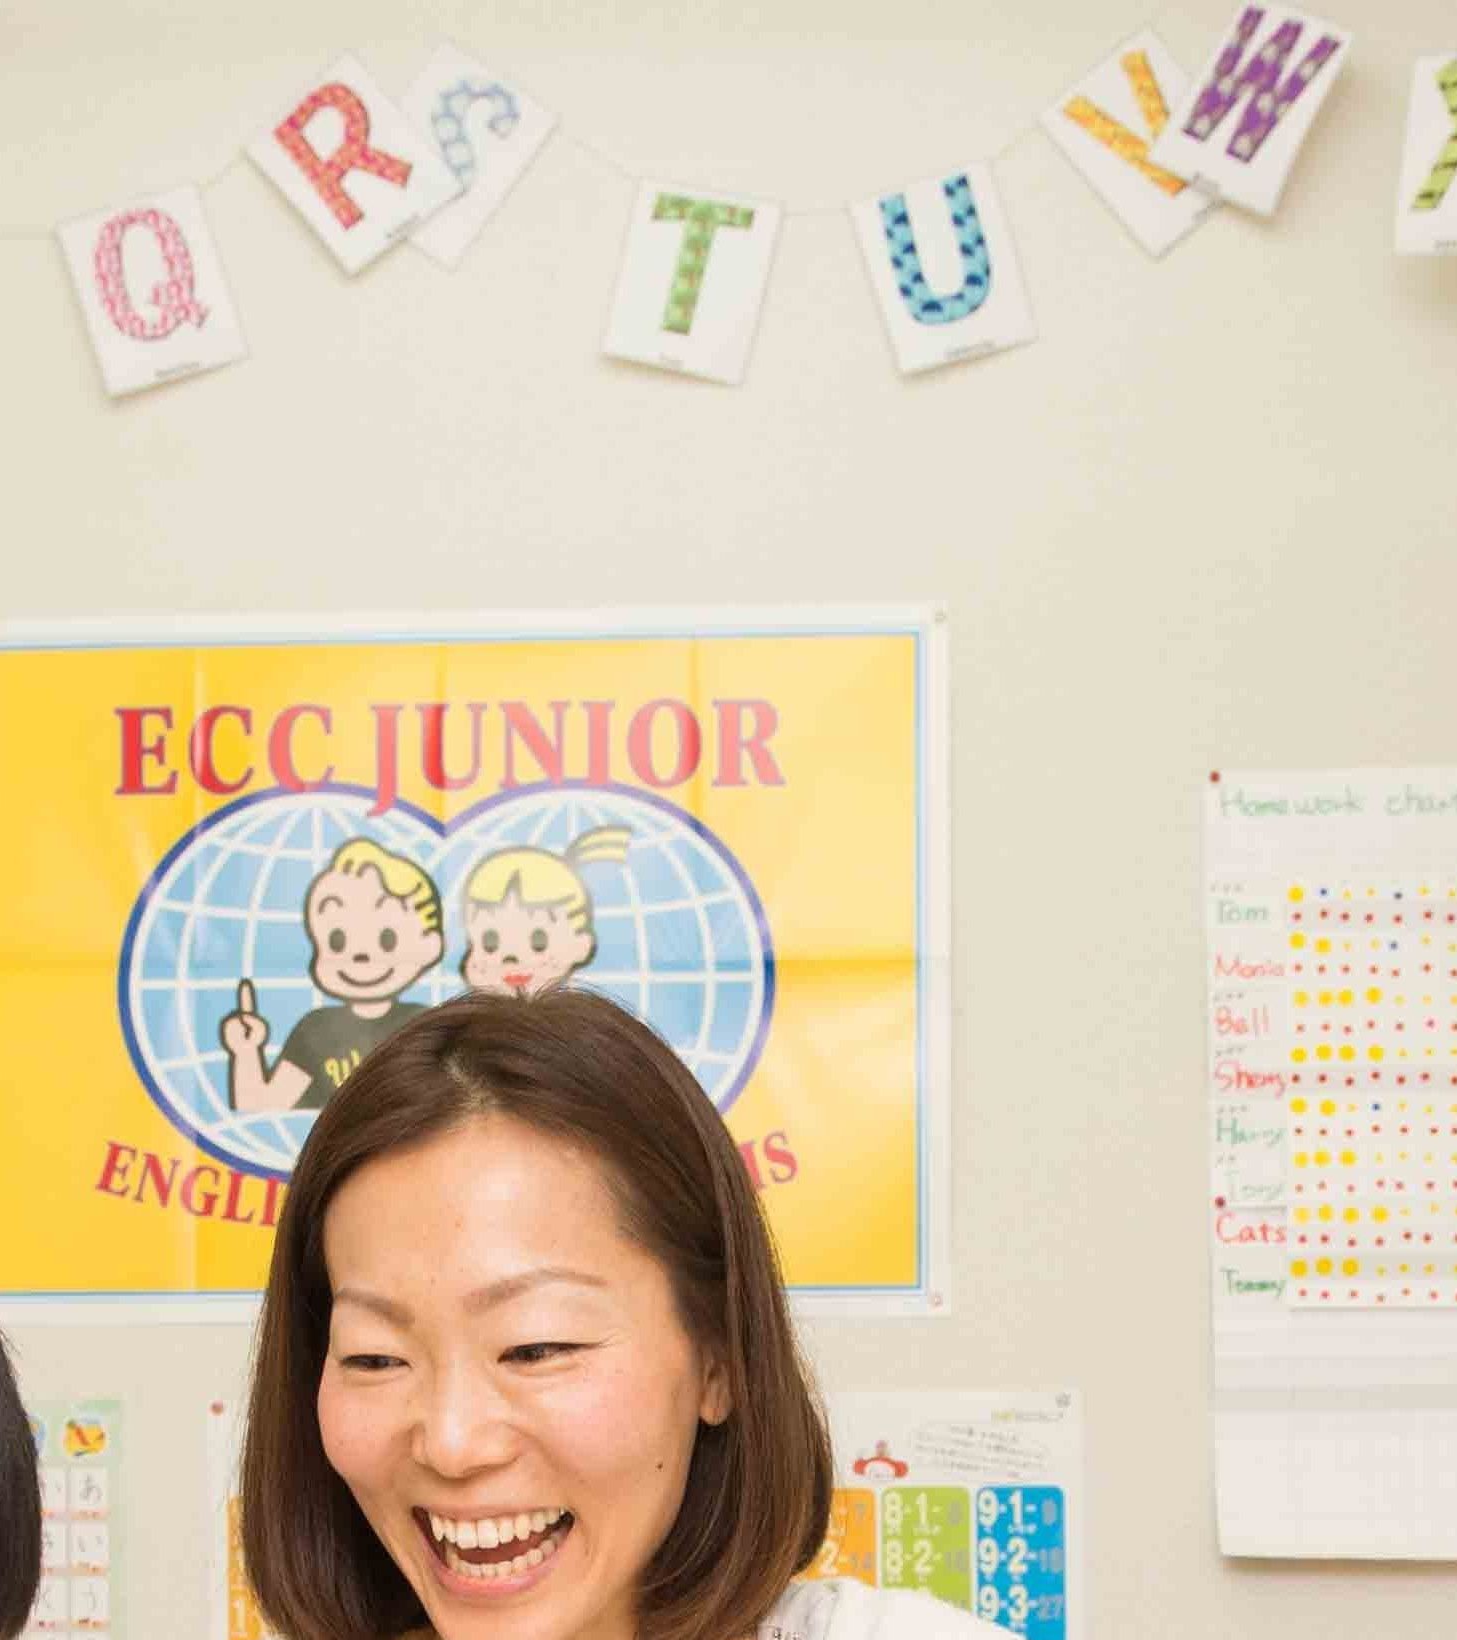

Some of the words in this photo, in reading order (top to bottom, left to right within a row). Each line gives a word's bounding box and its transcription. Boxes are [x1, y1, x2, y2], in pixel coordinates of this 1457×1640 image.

[1182, 4, 1341, 164] W
[273, 81, 414, 231] R
[93, 207, 210, 342] Q
[651, 190, 755, 335] T
[879, 173, 991, 326] U
[113, 703, 337, 797] ECC
[367, 698, 786, 818] JUNIOR
[95, 1141, 284, 1227] ENGLI
[1215, 1212, 1288, 1244] Cats
